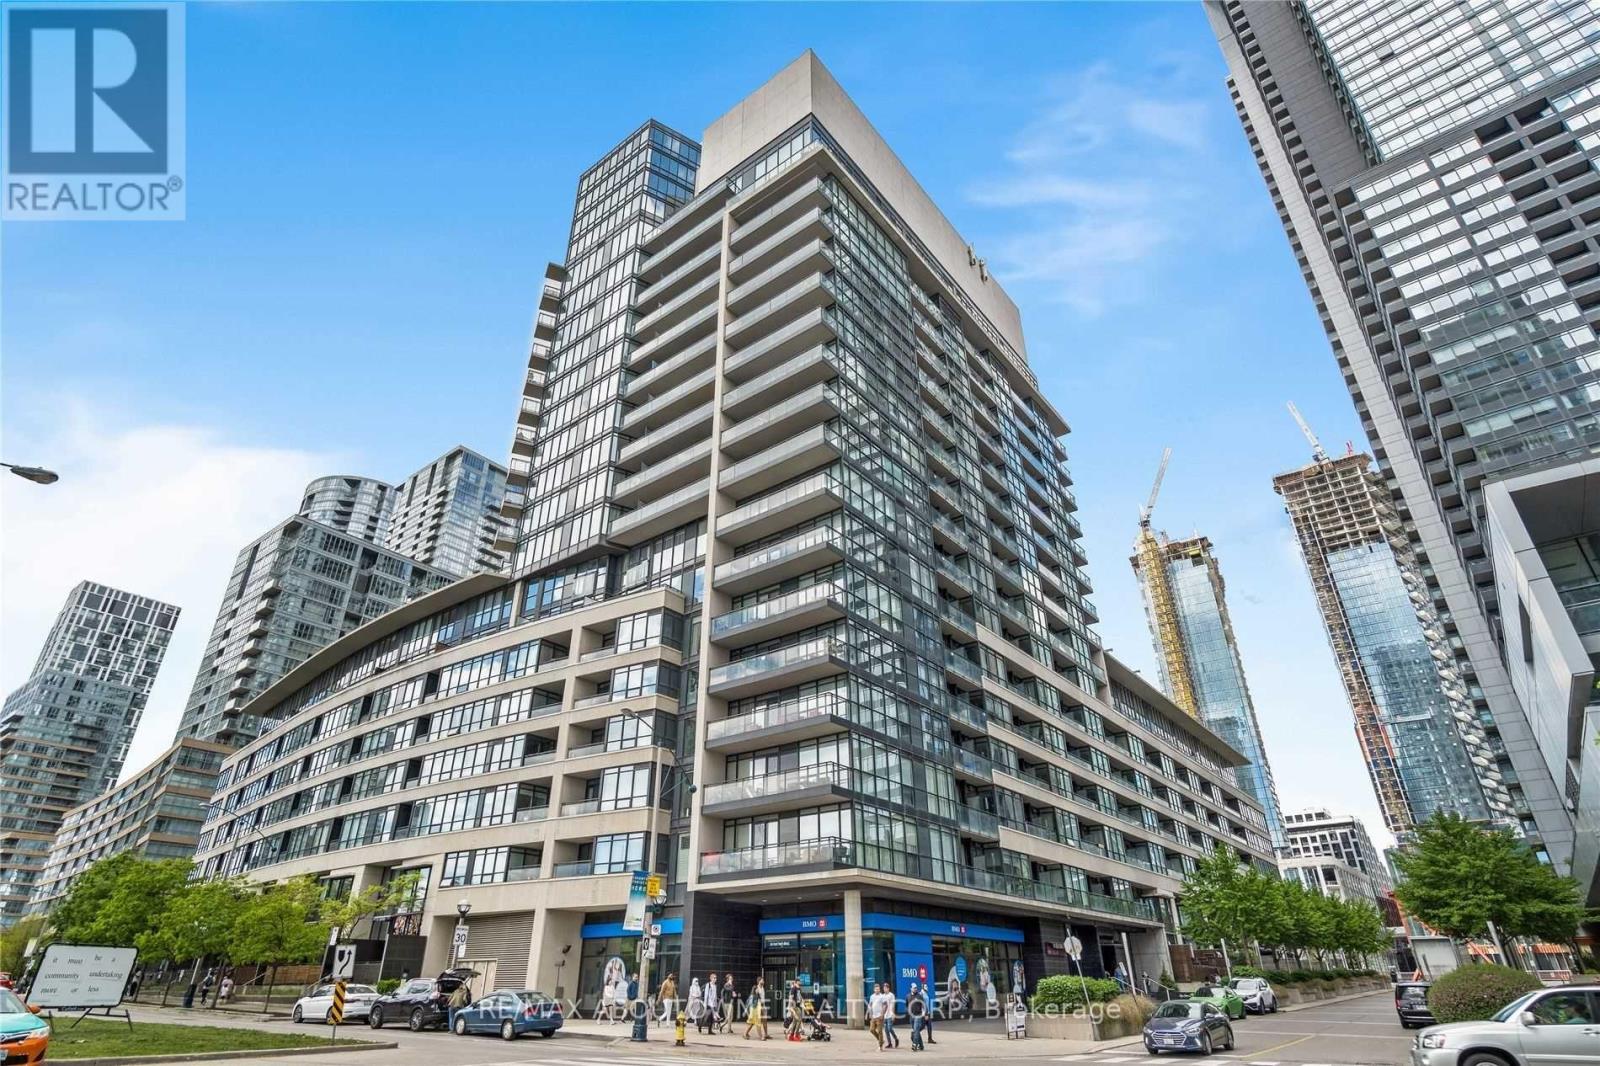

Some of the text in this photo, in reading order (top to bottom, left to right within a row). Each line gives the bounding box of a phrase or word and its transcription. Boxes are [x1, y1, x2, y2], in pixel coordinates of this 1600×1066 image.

[802, 920, 817, 928] BMO
[455, 933, 466, 943] 30
[67, 956, 84, 965] must
[44, 969, 123, 980] community undertaking
[902, 967, 917, 978] BMO
[87, 985, 100, 993] less
